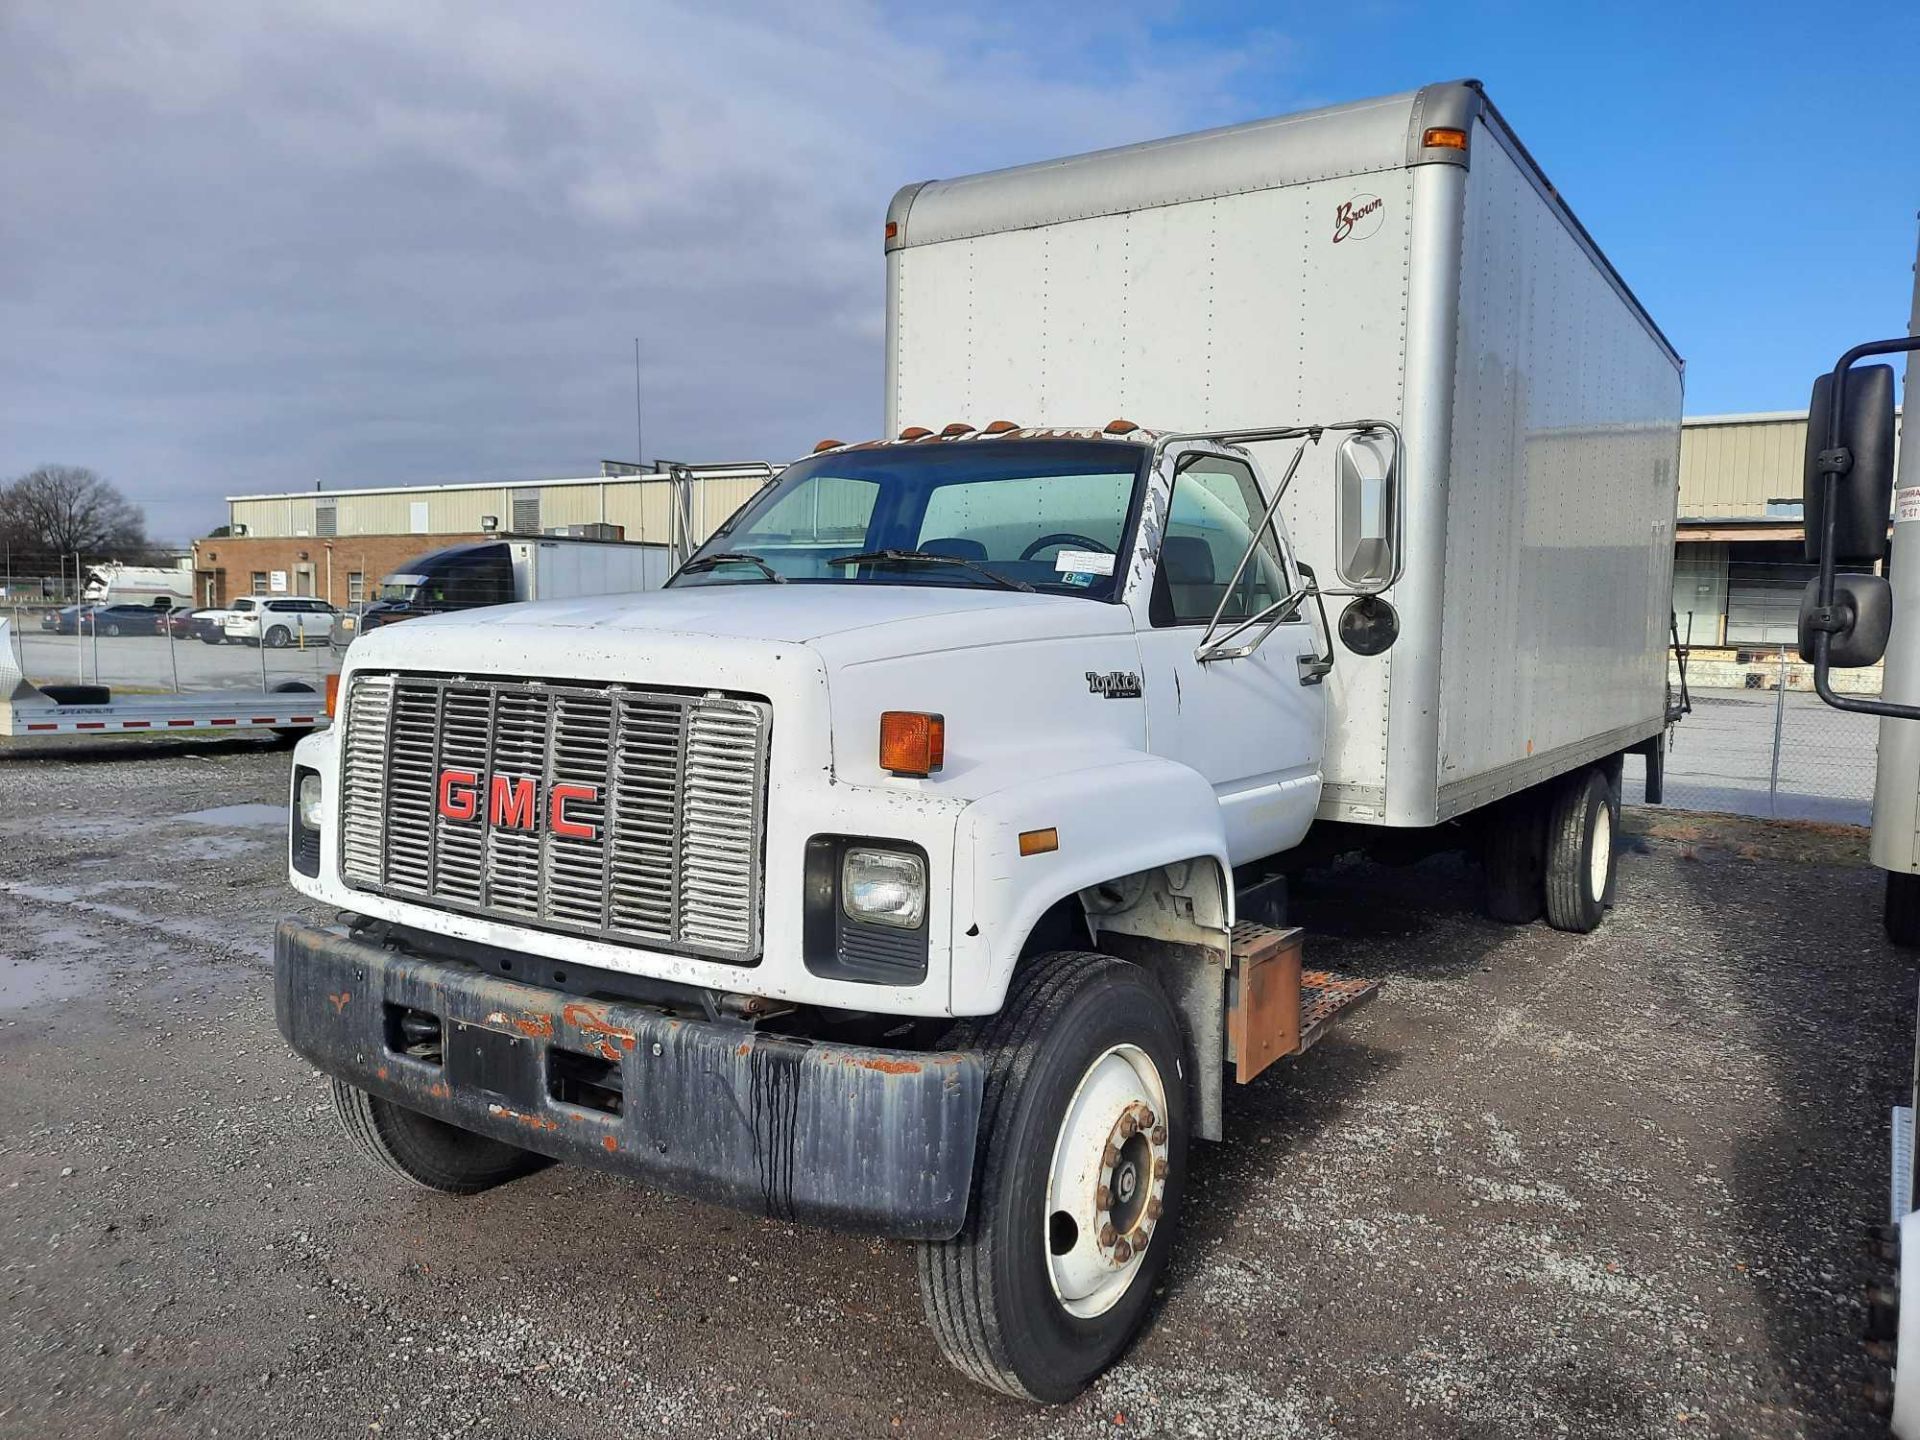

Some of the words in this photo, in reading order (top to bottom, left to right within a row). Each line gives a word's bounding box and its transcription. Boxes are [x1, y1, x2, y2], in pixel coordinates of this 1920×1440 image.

[1333, 197, 1382, 243] Brown
[1066, 573, 1074, 582] 8
[1085, 672, 1141, 697] TopKick
[439, 769, 597, 840] GMC
